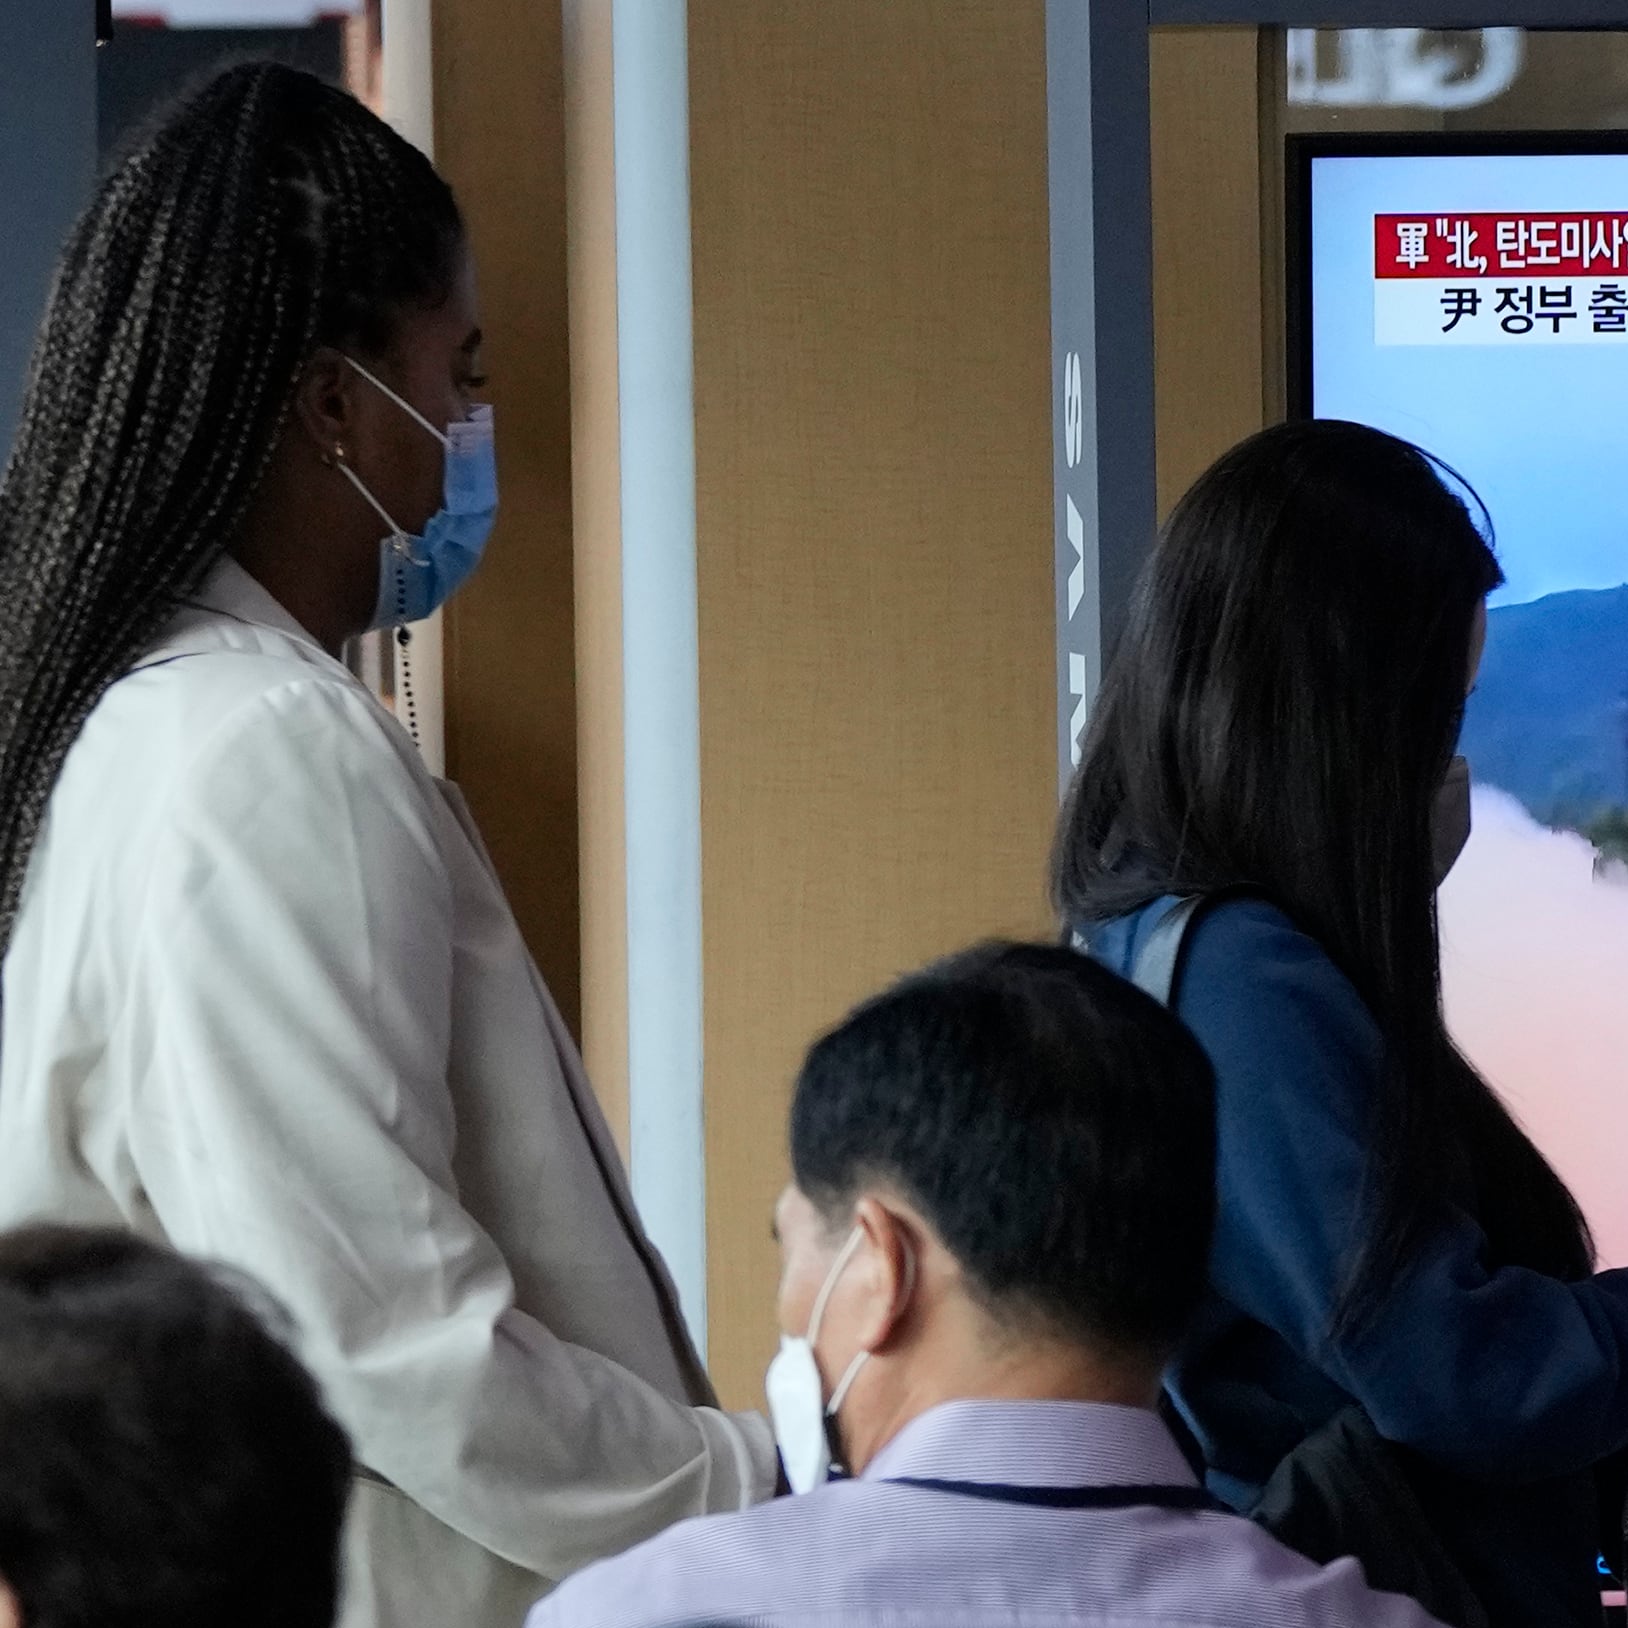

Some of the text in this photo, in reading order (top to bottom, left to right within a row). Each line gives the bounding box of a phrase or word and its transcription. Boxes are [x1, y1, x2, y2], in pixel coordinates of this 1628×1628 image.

[1395, 222, 1429, 270] 軍
[1440, 288, 1482, 333] 尹
[1494, 286, 1577, 333] 정부
